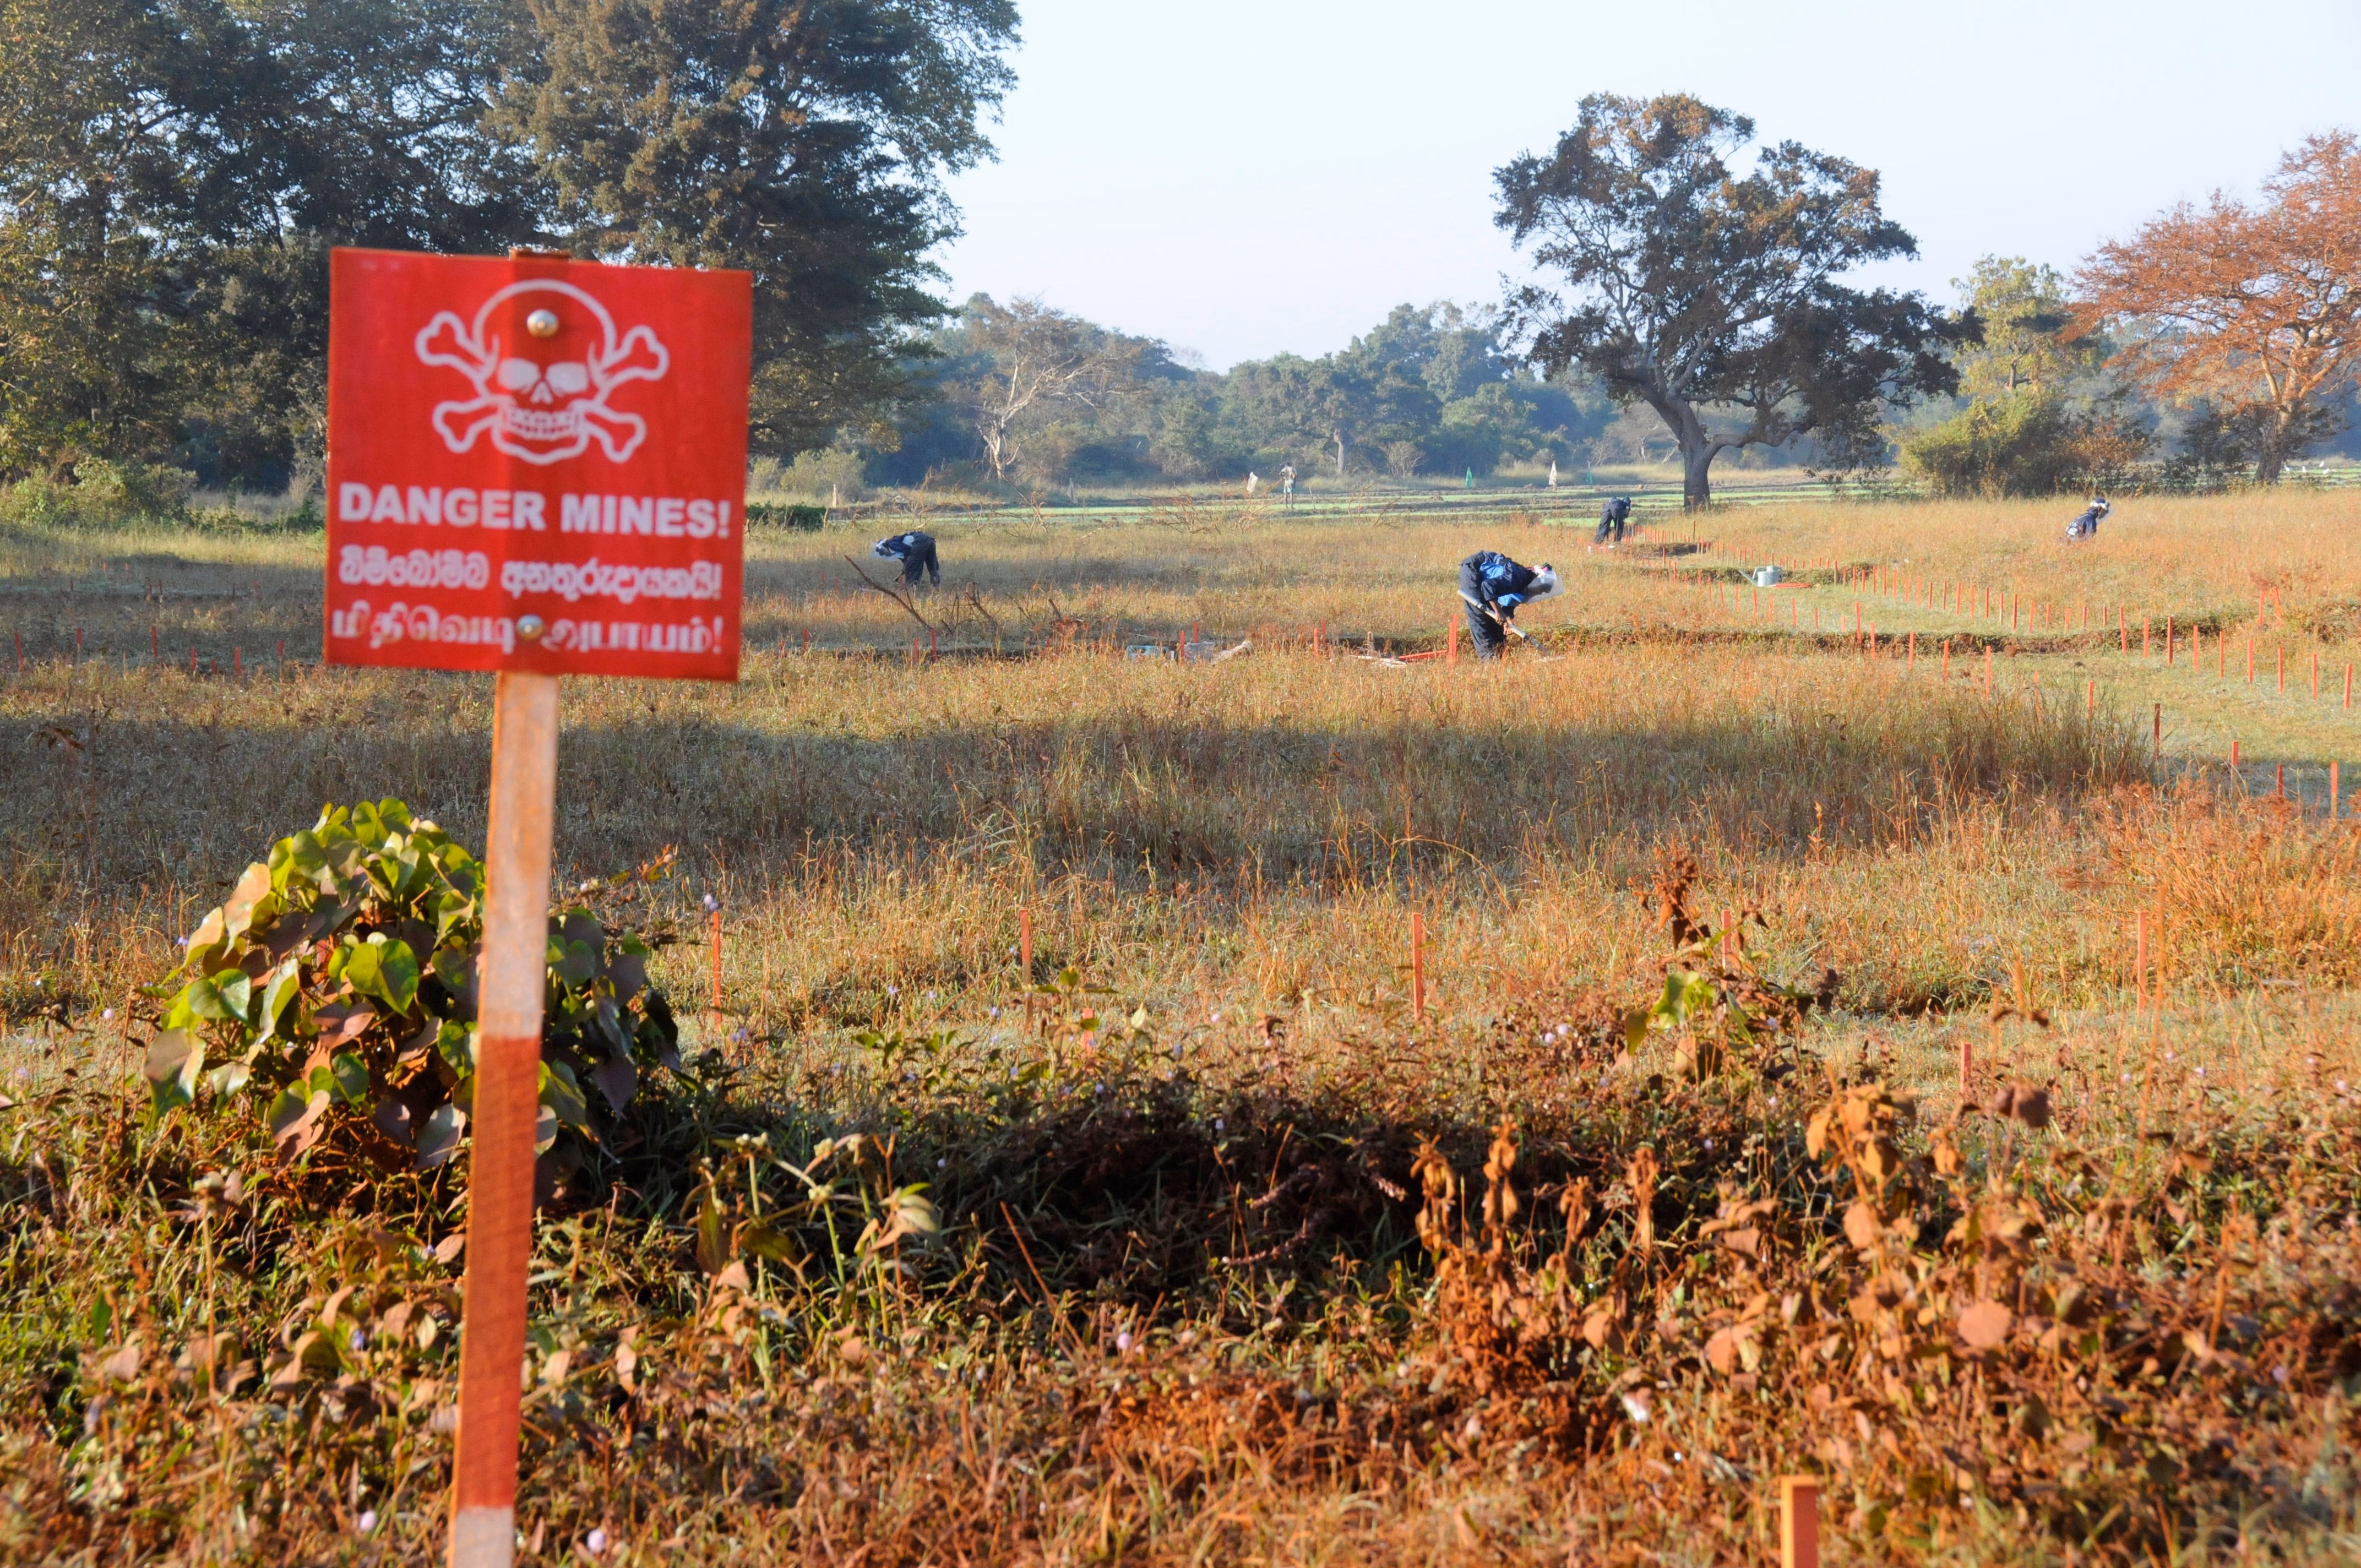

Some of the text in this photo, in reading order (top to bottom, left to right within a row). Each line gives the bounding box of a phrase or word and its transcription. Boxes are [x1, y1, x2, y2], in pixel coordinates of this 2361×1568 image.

[339, 482, 731, 538] DANGER MINES!
[332, 600, 723, 655] மிதிவெடி அபாயம்!
